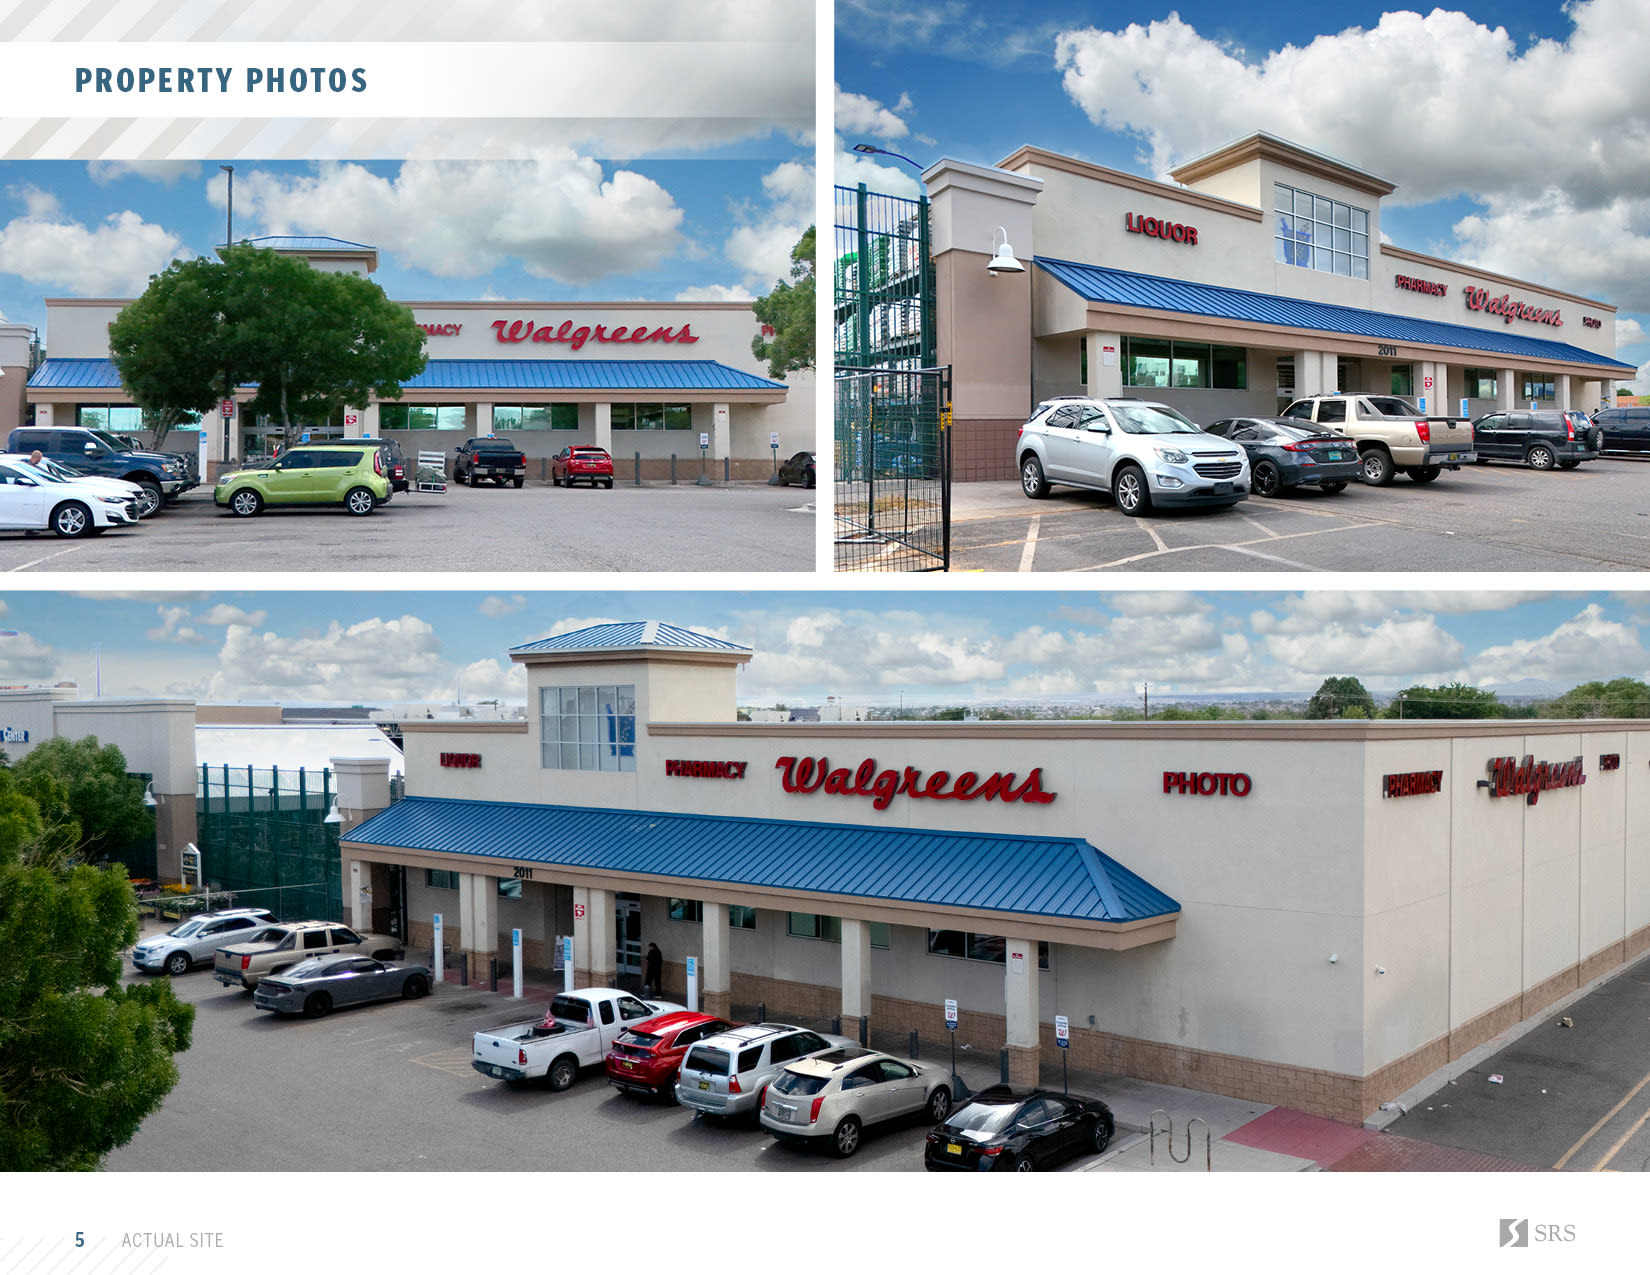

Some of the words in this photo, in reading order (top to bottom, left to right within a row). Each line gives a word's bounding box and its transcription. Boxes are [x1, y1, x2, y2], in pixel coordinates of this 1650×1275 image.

[1126, 212, 1198, 246] LIQUOR
[1395, 274, 1448, 297] PHARMACY
[1464, 286, 1563, 325] Walgreens
[490, 319, 700, 351] Walgreens
[1377, 345, 1397, 357] 2011
[665, 759, 748, 779] PHARMACY
[1486, 754, 1587, 806] Walgreens
[775, 756, 1058, 811] Walgreens
[1163, 771, 1253, 797] PHOTO
[1383, 770, 1443, 798] PHARMACY
[513, 866, 533, 879] 2011
